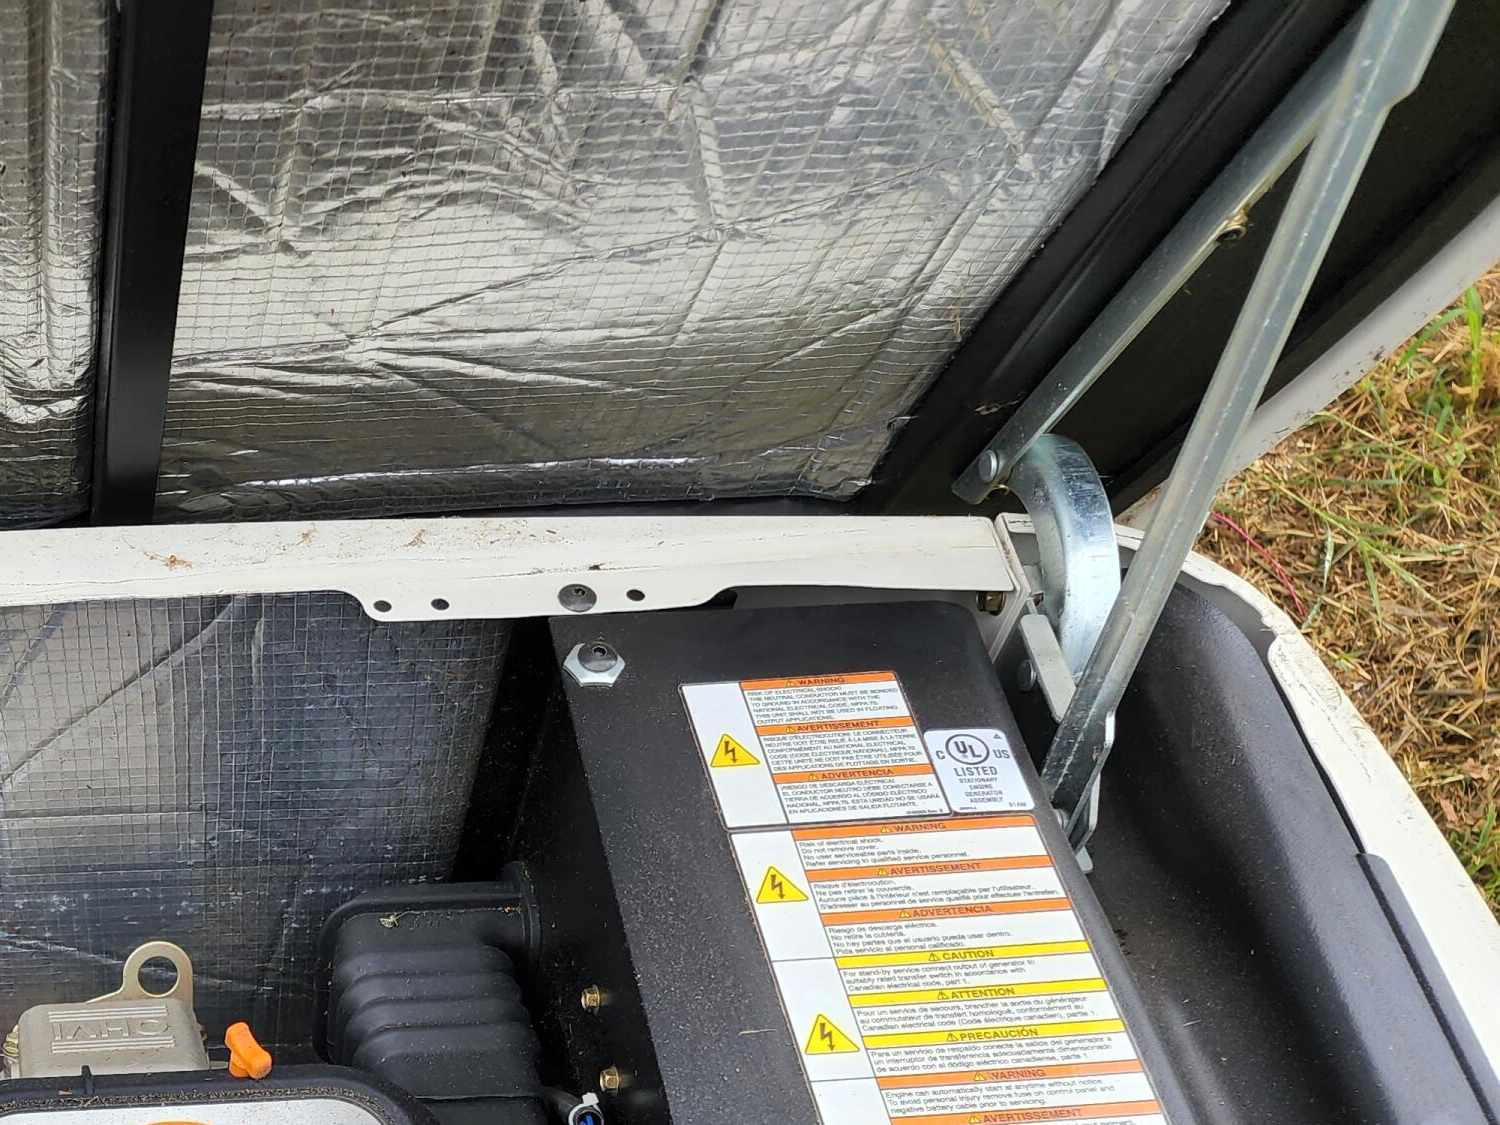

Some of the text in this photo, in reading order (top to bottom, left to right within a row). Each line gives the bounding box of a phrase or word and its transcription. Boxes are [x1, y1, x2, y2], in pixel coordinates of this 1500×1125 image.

[797, 676, 844, 686] WARNING
[795, 720, 879, 732] AVERTISSEMENT
[992, 749, 1010, 759] US
[821, 768, 894, 779] ADVERTENCIA
[954, 766, 997, 776] LISTED
[893, 822, 946, 832] WARNING
[889, 862, 982, 874] AVERTISSEMENT
[911, 905, 993, 916] ADVERTENCIA
[941, 949, 995, 960] CAUTION
[950, 988, 1015, 998] ATTENTION
[958, 1027, 1038, 1040] PRECAUCIÓN
[982, 1109, 1083, 1122] AVERTISSEMENT
